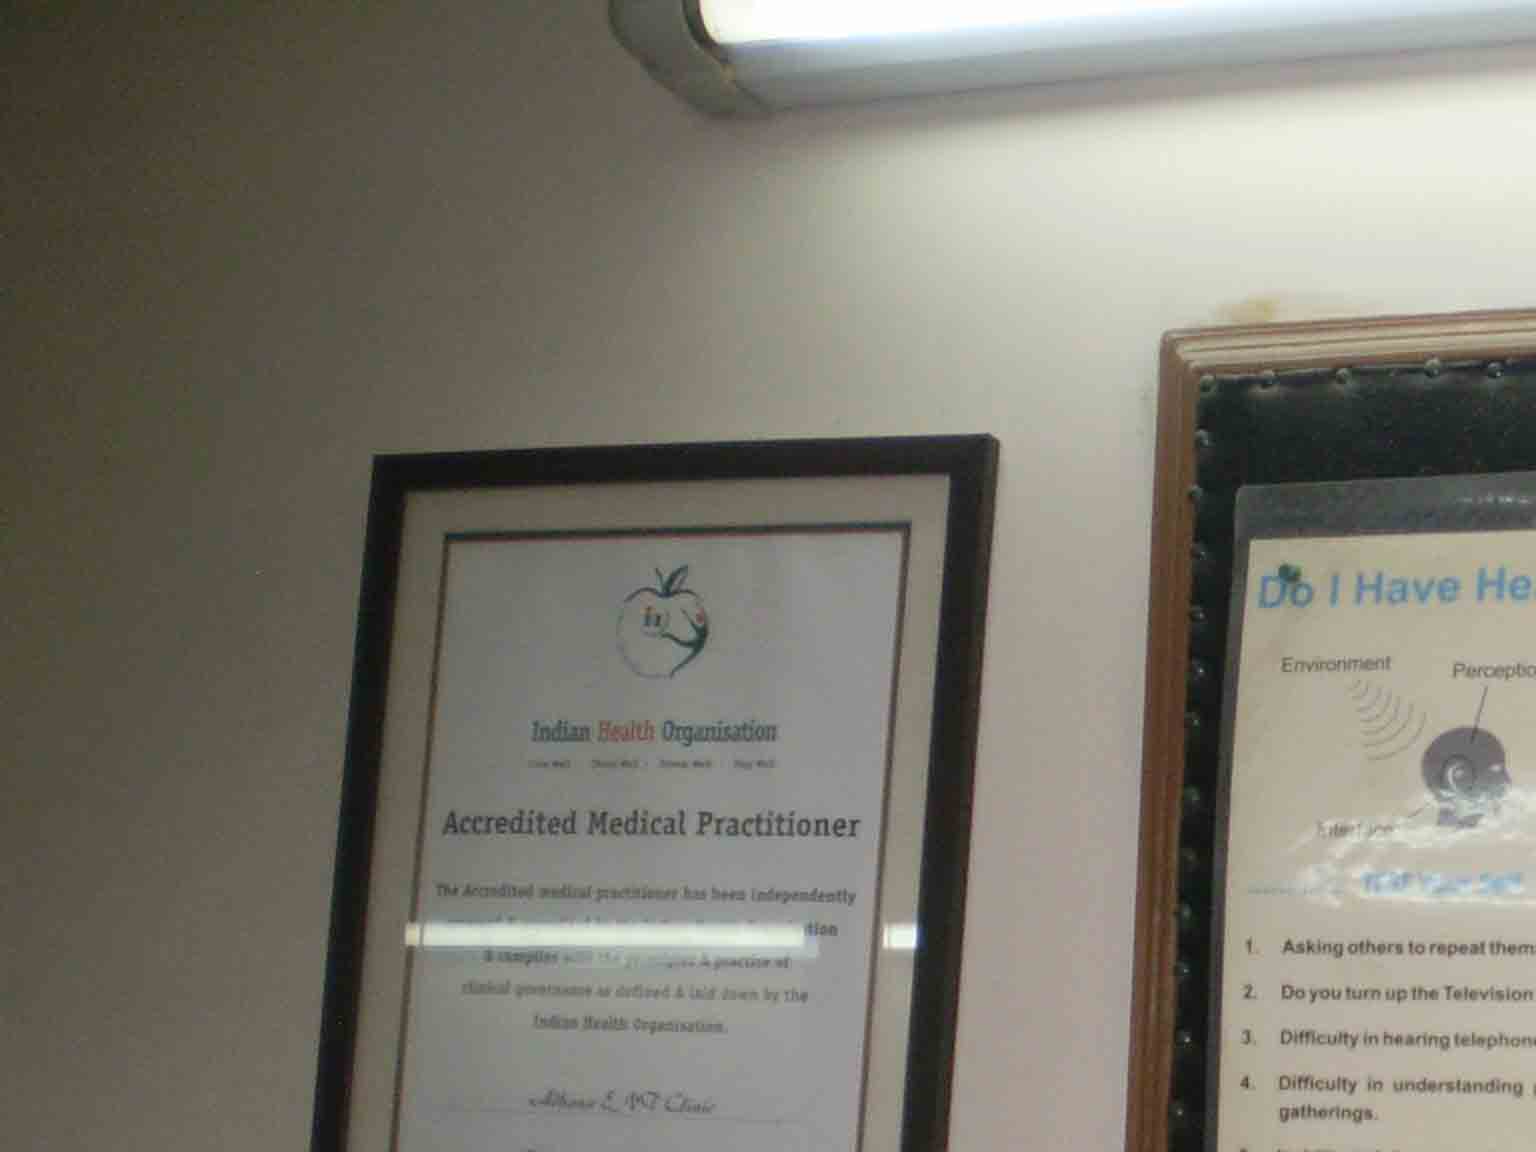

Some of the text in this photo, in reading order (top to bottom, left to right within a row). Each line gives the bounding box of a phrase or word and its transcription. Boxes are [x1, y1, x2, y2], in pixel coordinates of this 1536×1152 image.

[1258, 572, 1314, 609] Do
[1330, 572, 1338, 606] I
[1355, 571, 1461, 604] Have
[1281, 655, 1392, 674] Environment
[531, 720, 778, 747] Indian Health Organisation
[442, 810, 861, 838] Accredited Medical Practitioner
[1283, 939, 1344, 959] Asking
[1347, 940, 1404, 955] others
[1408, 941, 1426, 955] to
[1430, 941, 1486, 959] repeat
[1281, 985, 1307, 1000] Do
[1308, 989, 1342, 1005] you
[1345, 987, 1380, 1001] turn
[1384, 990, 1408, 1005] up
[1411, 986, 1440, 1001] the
[1444, 986, 1534, 1002] Television
[1280, 1031, 1359, 1051] Difficulty
[1363, 1032, 1379, 1046] in
[1382, 1032, 1450, 1052] hearing
[1278, 1075, 1357, 1096] Difficulty
[1367, 1077, 1383, 1092] in
[1393, 1078, 1524, 1098] understanding
[1279, 1105, 1379, 1125] gatherings.
